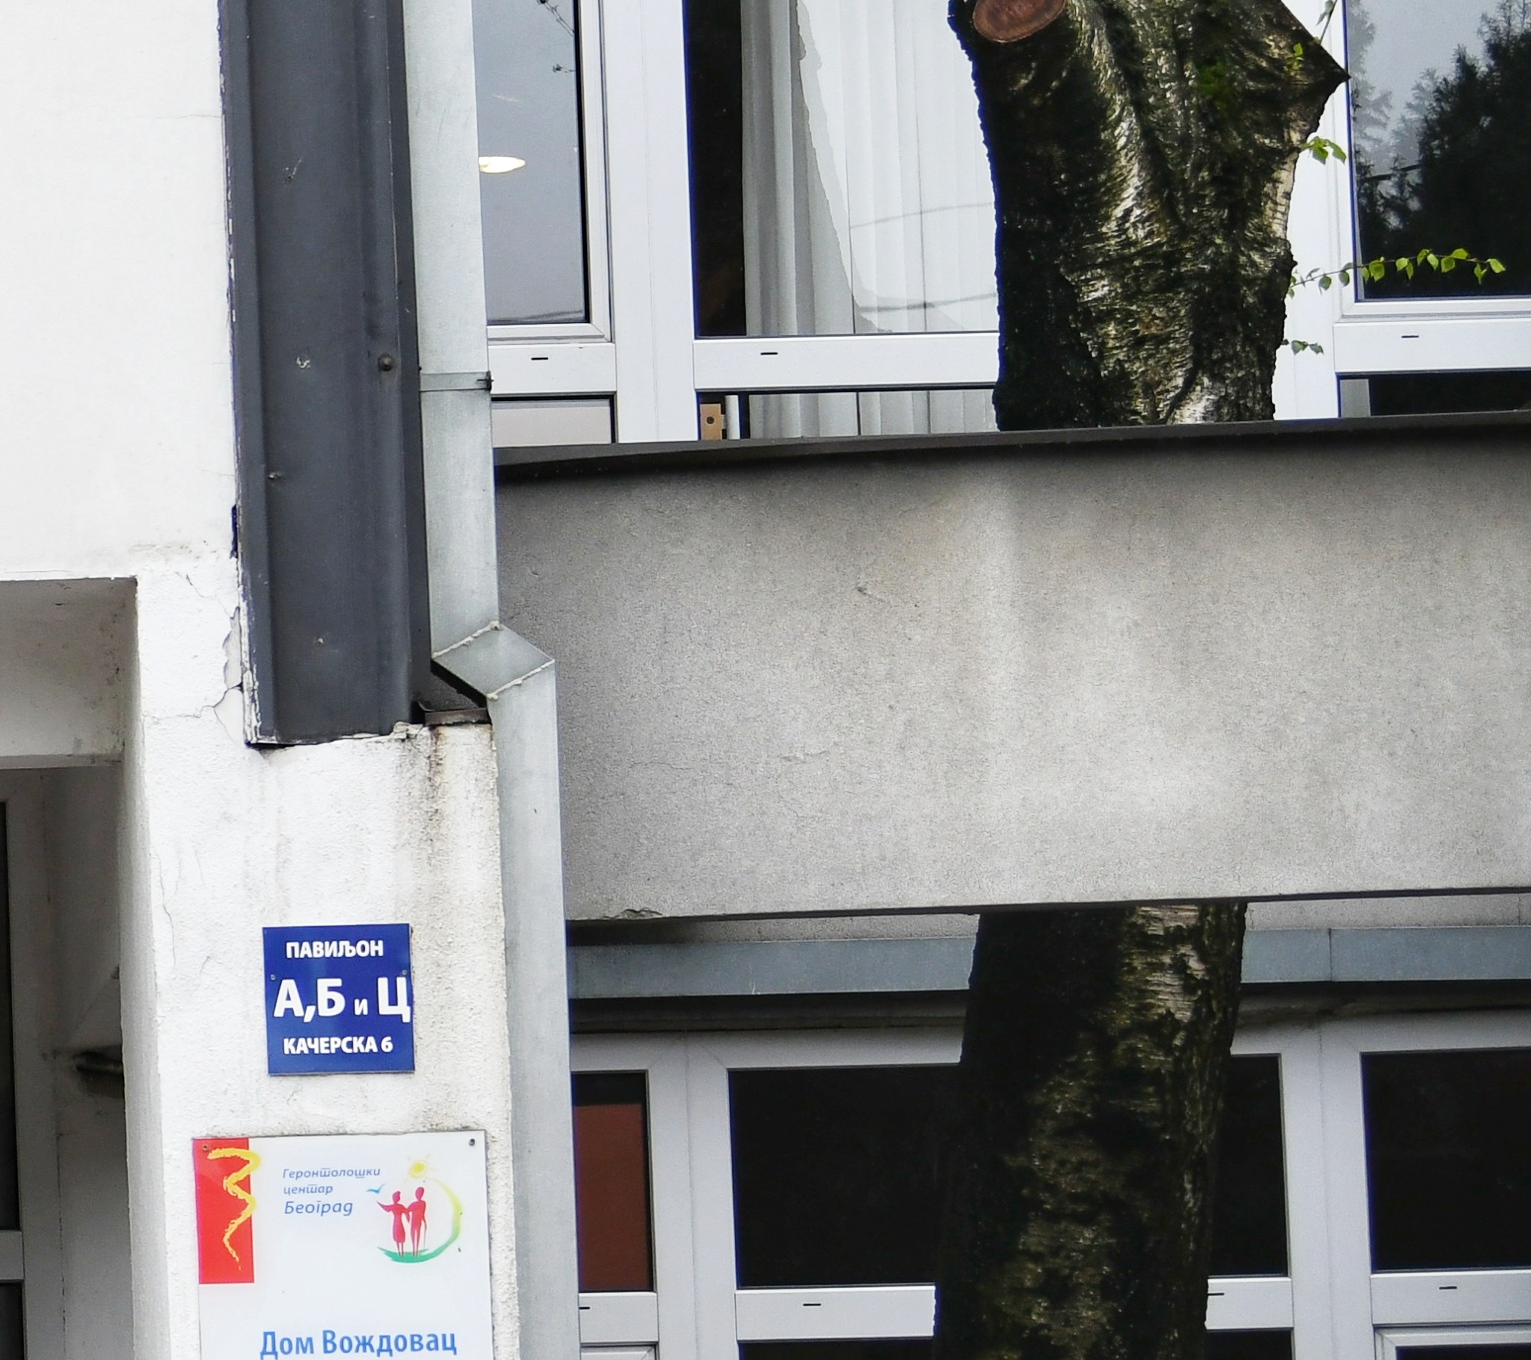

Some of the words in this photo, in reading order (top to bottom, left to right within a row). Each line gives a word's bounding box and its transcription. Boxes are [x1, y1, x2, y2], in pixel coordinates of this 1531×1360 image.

[286, 940, 384, 959] ПАВИЉОН
[354, 997, 369, 1015] и
[377, 977, 411, 1023] Ц
[283, 1036, 378, 1055] КАЧЕРСКА
[381, 1036, 393, 1053] 6
[282, 1167, 381, 1180] Геронтолошки
[283, 1183, 334, 1196] центар
[284, 1200, 353, 1216] Београд
[260, 1331, 314, 1360] Дом
[322, 1329, 458, 1357] Вождовац
